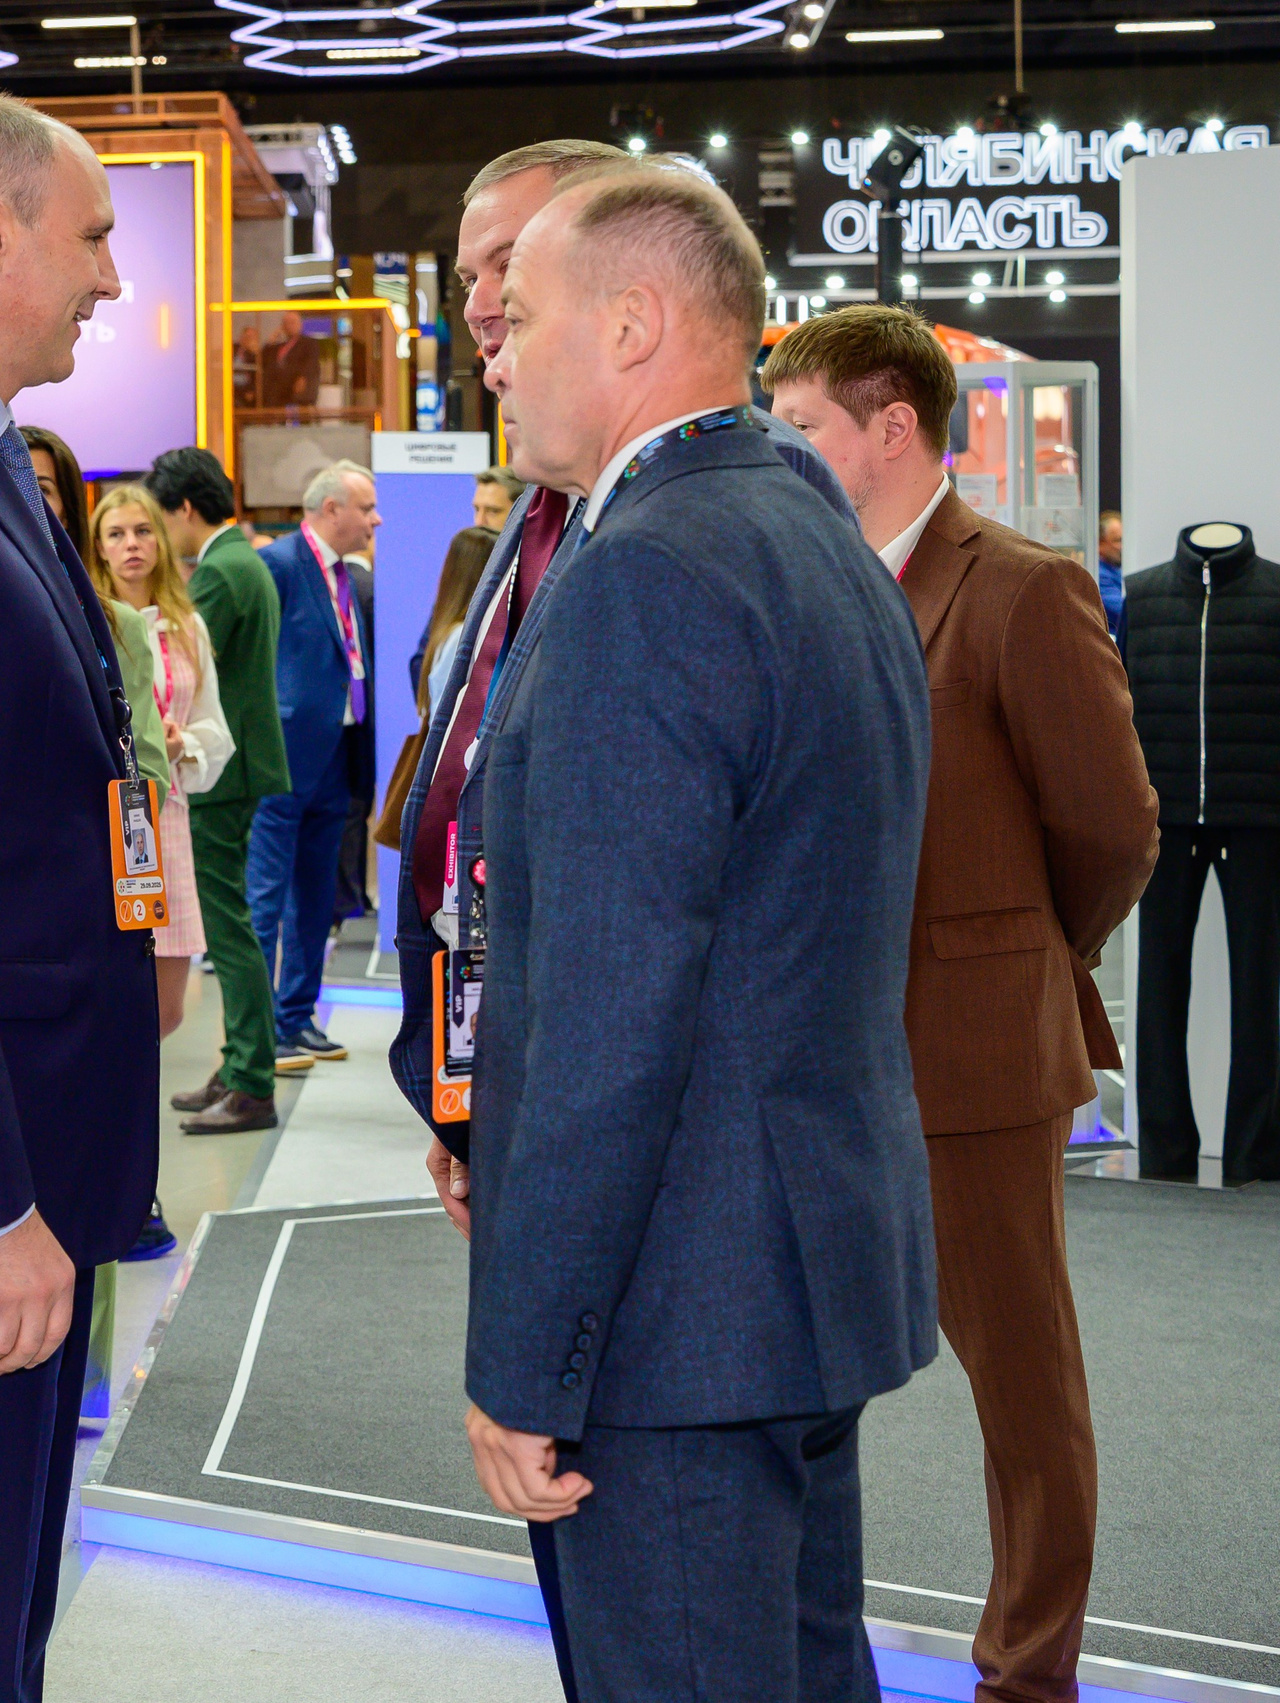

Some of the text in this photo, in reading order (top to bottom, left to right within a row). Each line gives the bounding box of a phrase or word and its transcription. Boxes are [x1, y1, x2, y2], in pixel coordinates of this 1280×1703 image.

[447, 833, 456, 879] EXHIBITOR
[136, 904, 143, 916] 2
[455, 994, 463, 1014] VIP
